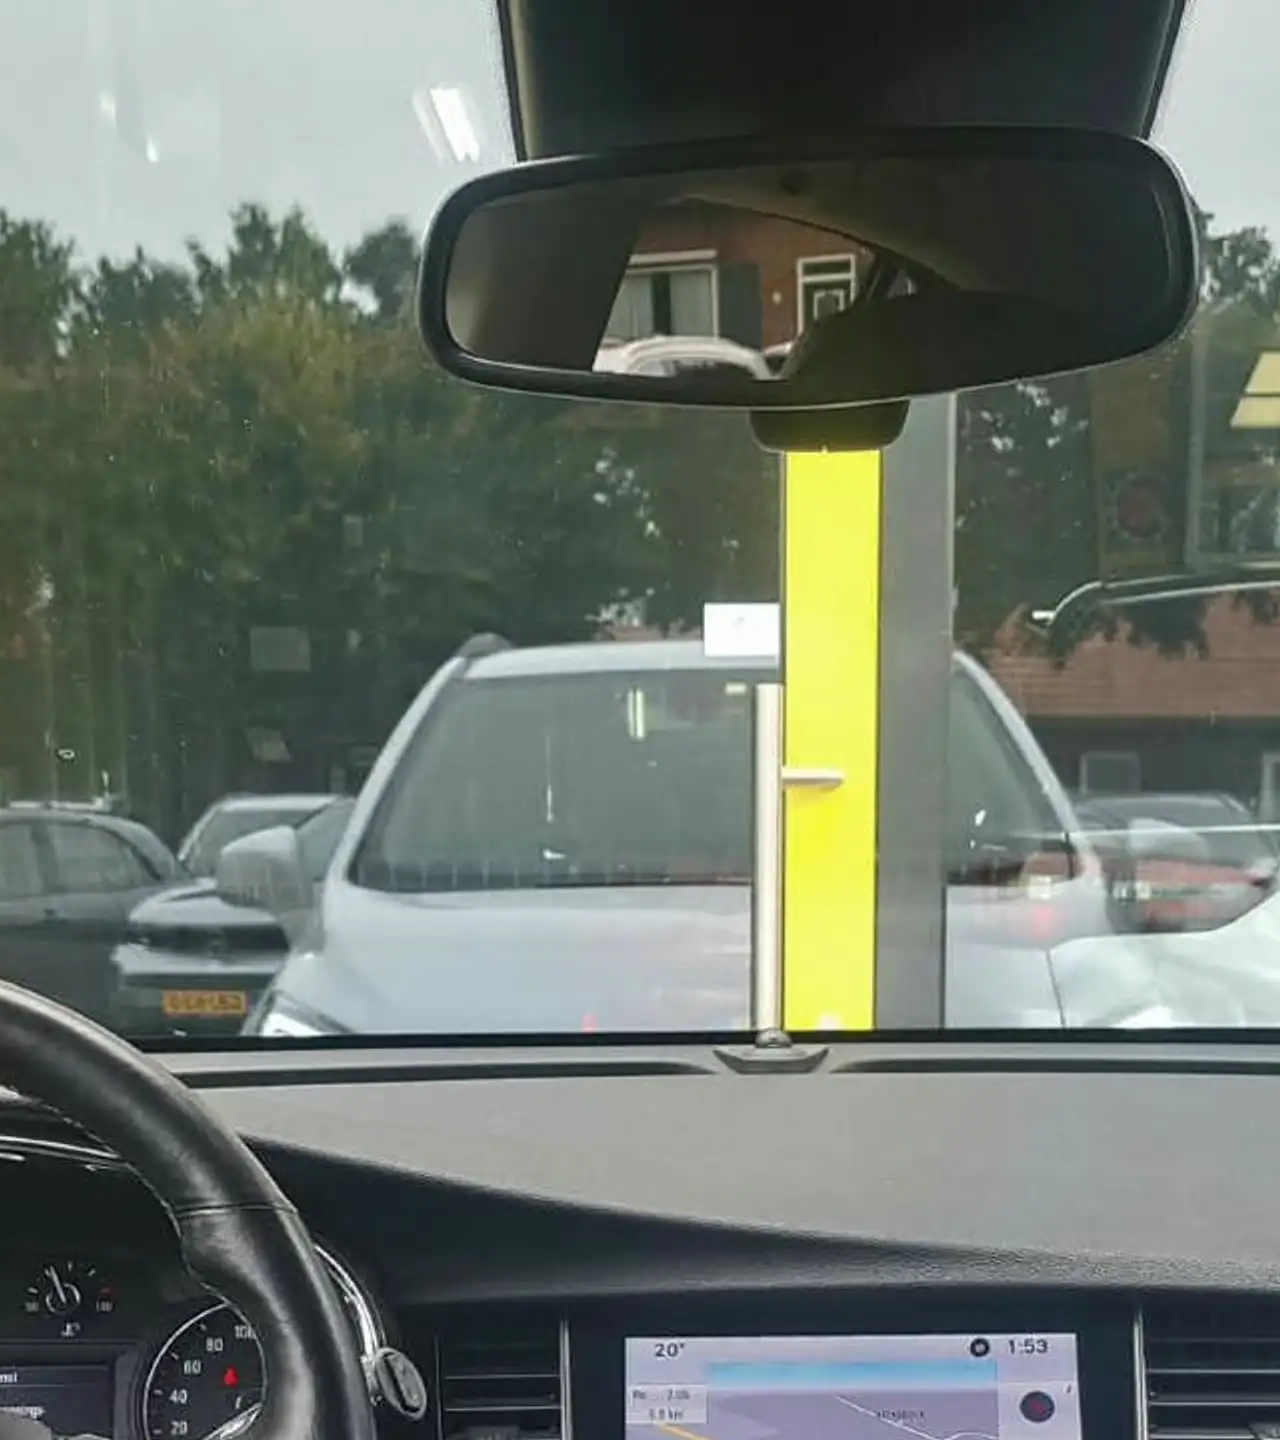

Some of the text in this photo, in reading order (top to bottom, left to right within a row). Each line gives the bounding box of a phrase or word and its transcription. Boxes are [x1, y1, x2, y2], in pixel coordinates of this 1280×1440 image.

[1008, 1338, 1048, 1354] 1:53
[169, 1388, 188, 1404] 40
[170, 1420, 188, 1435] 20
